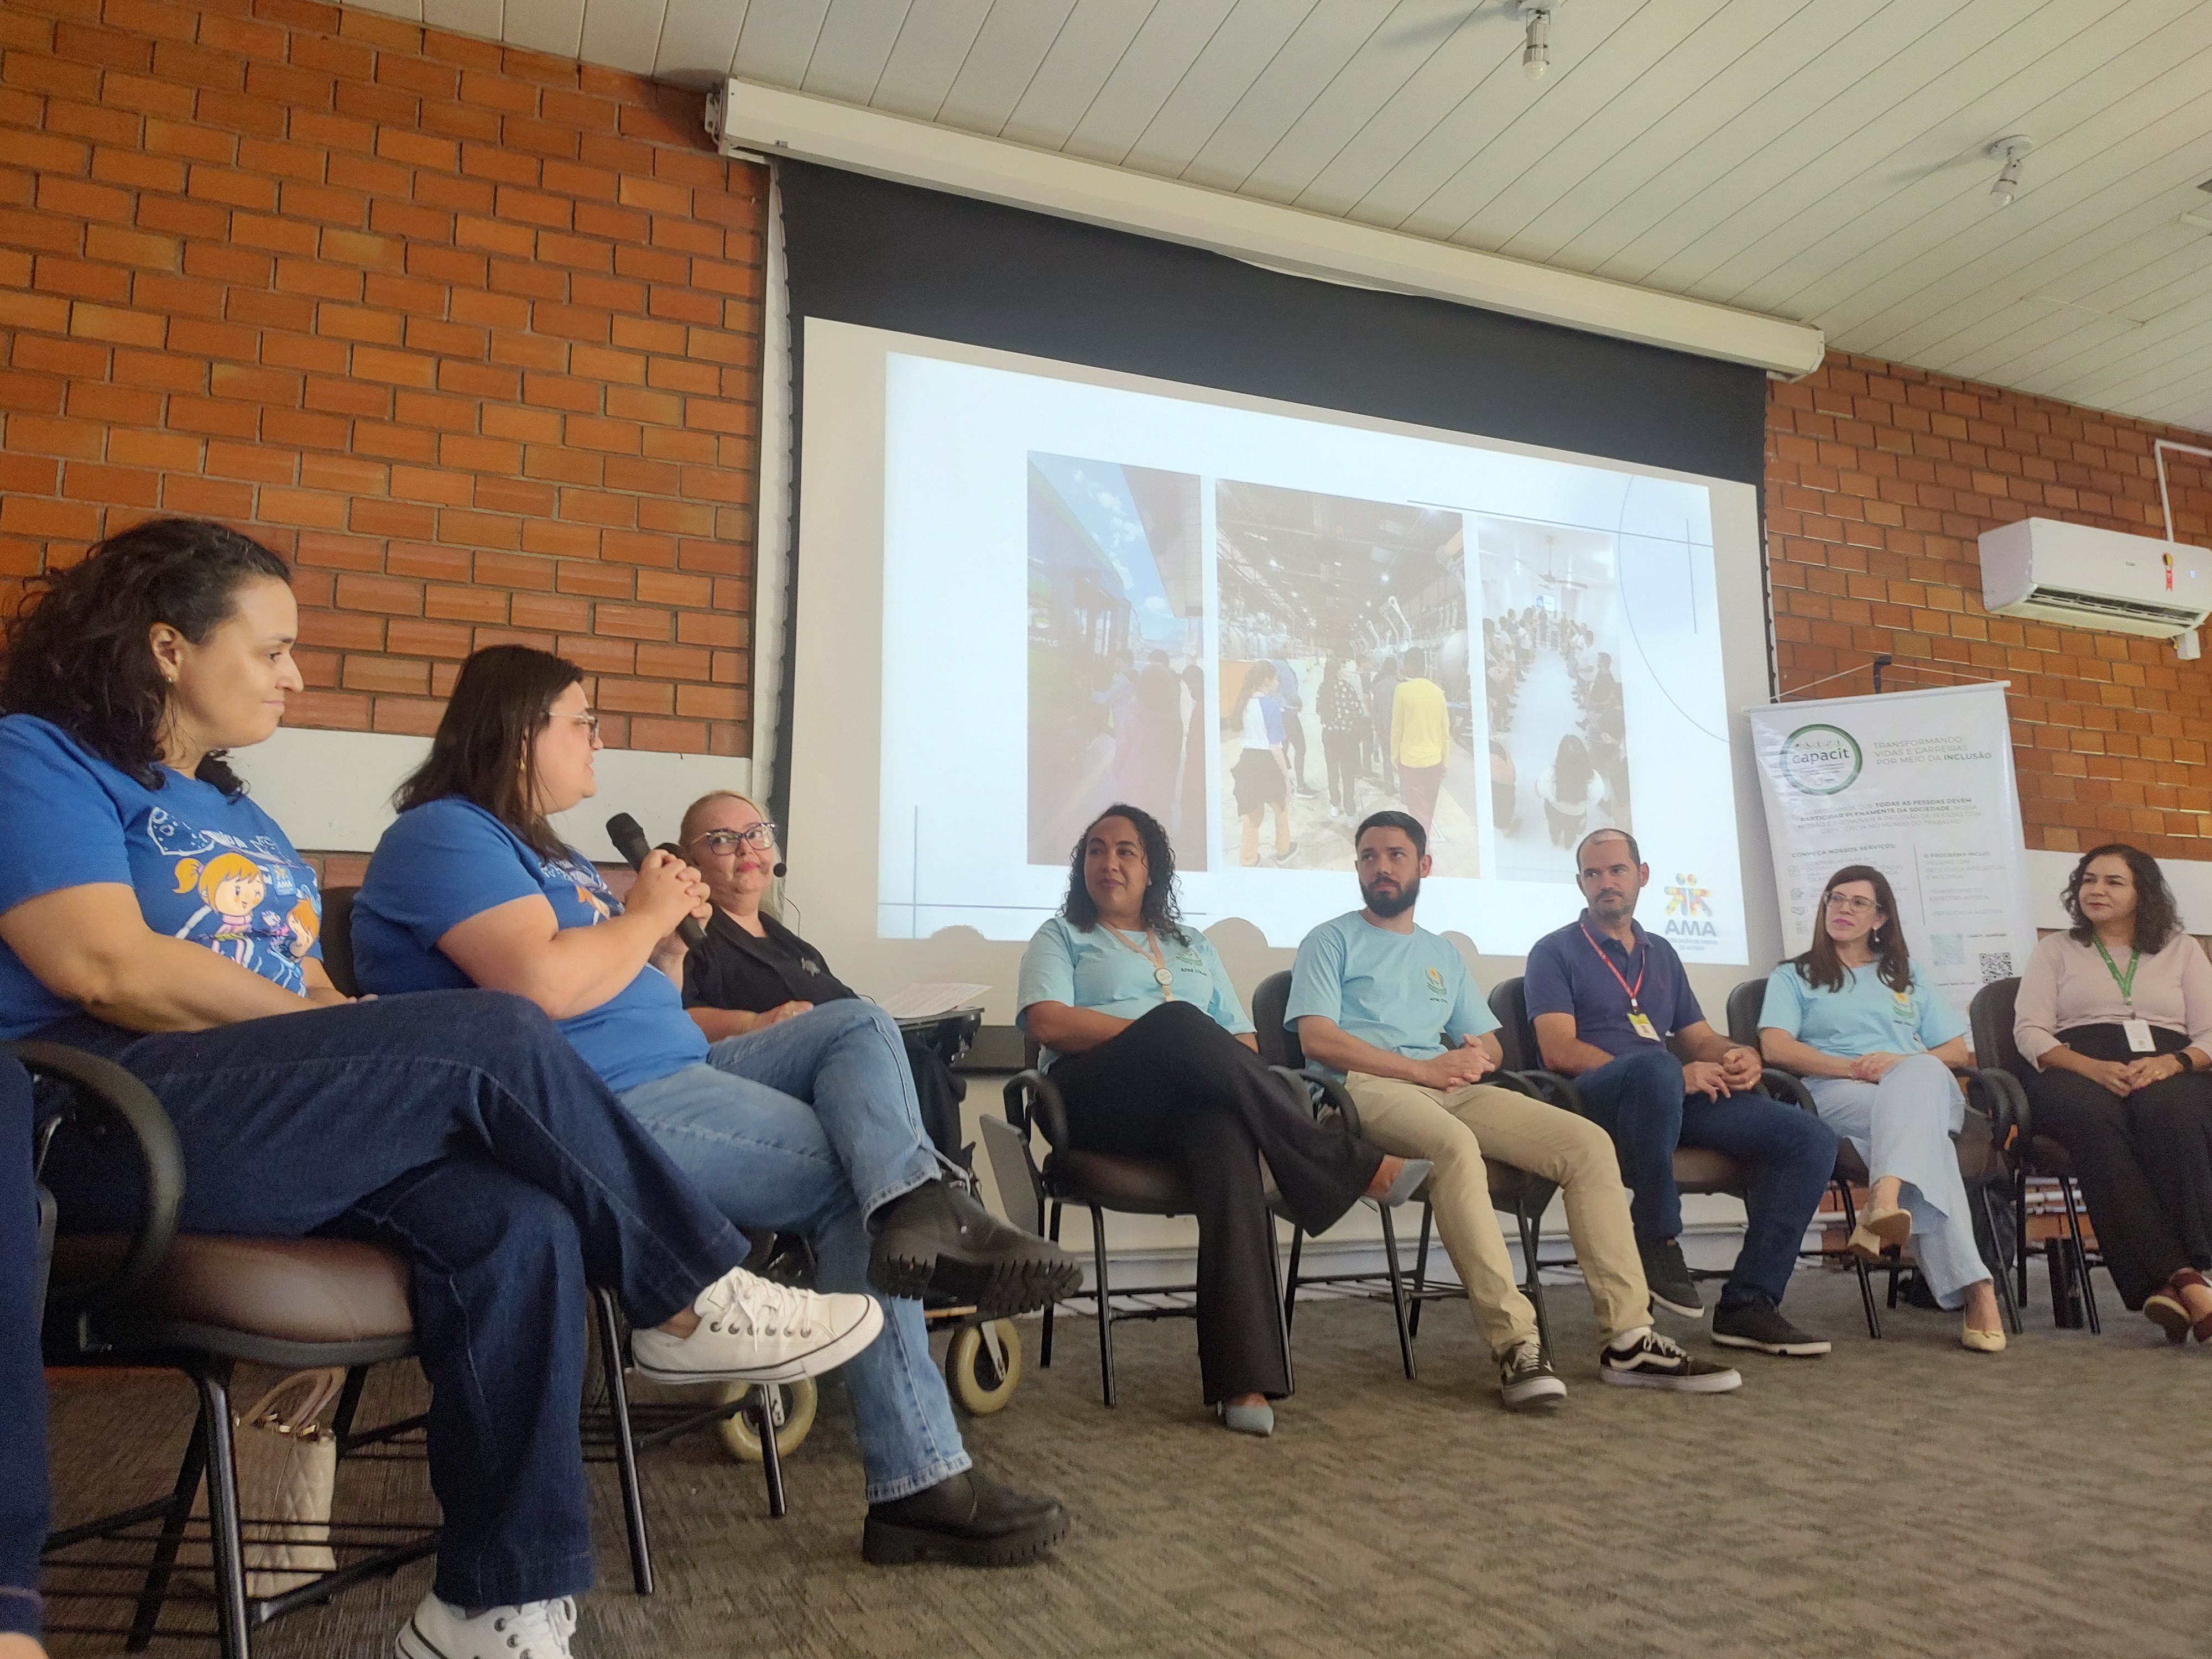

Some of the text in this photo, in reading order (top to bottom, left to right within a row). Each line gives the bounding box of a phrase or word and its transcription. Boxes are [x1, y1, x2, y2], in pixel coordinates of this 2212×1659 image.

[1873, 736, 1963, 749] TRANSFORMANDO
[1792, 748, 1850, 765] capacit
[1874, 749, 1903, 758] VIDAS
[1915, 745, 1968, 754] CARREIRAS
[1944, 752, 1992, 761] INCLUSÃO
[1665, 919, 1716, 937] AMA
